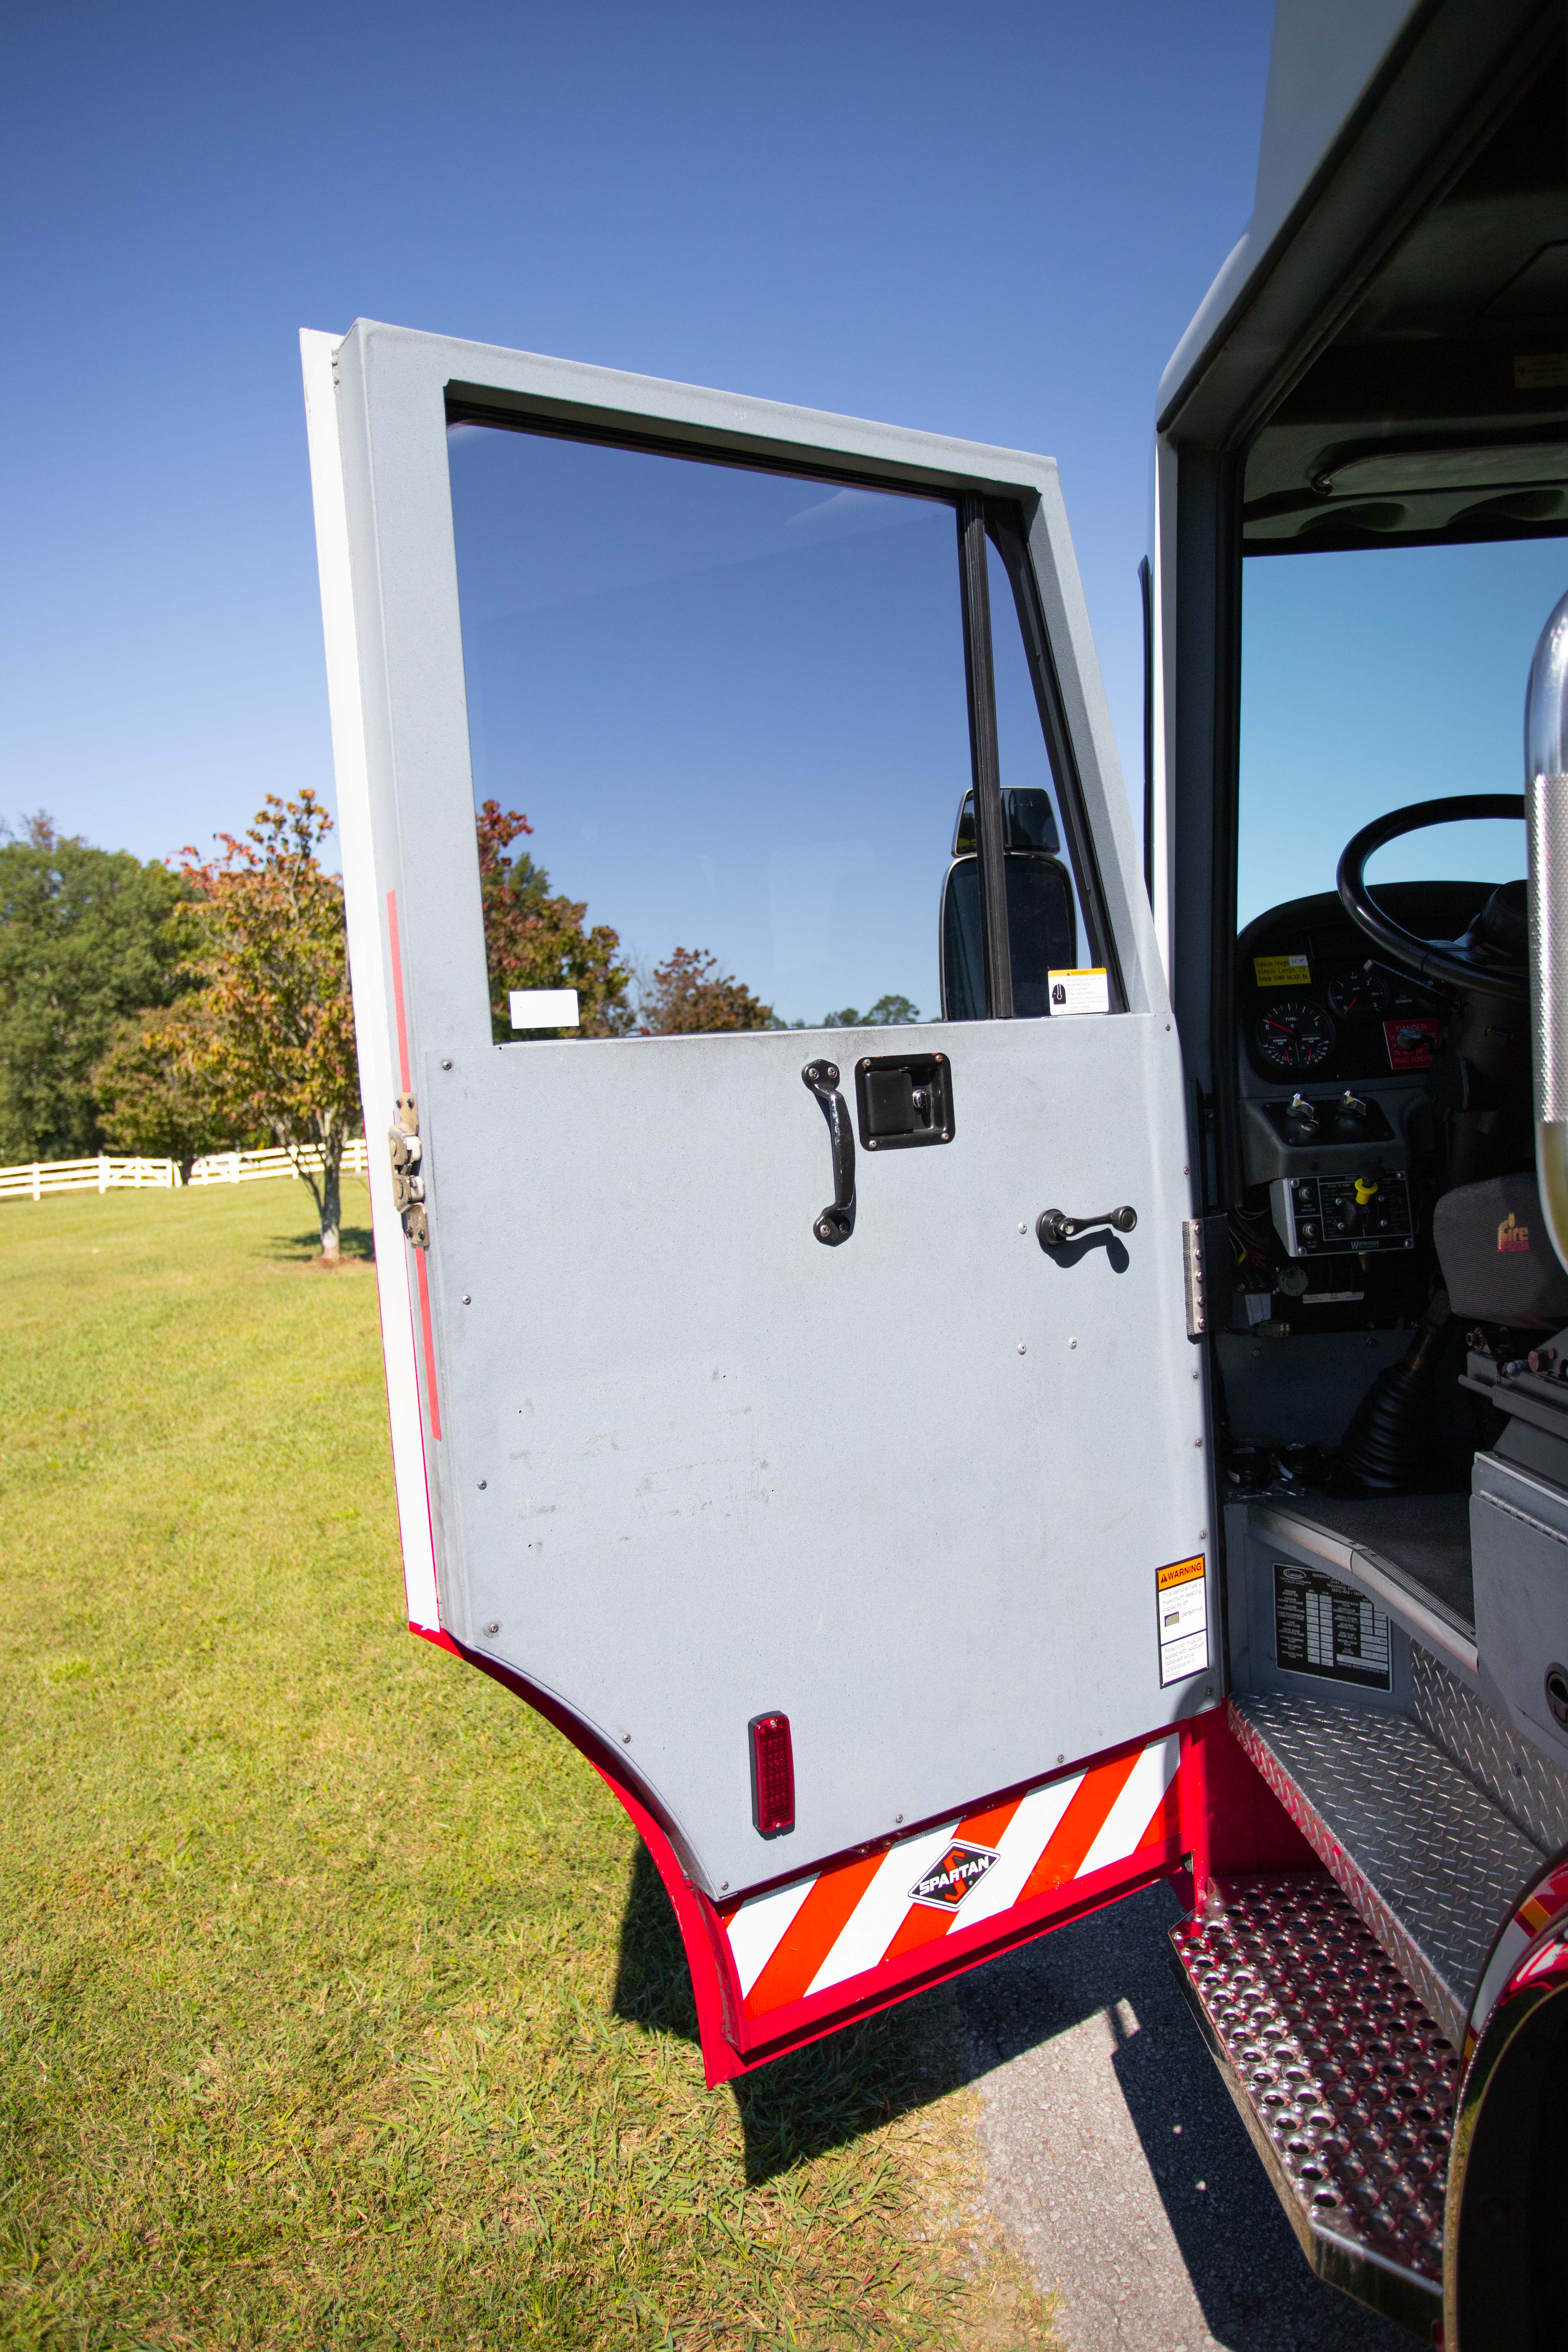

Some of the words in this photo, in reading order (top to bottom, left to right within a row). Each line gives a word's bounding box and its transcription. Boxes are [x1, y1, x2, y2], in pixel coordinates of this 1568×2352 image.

[1351, 1240, 1379, 1250] Waterous
[1167, 1563, 1201, 1580] WARNING
[1173, 1586, 1188, 1595] vehicle
[1162, 1595, 1184, 1605] maximum
[1185, 1588, 1201, 1598] seating
[1163, 1602, 1182, 1613] capacity
[1181, 1605, 1203, 1619] personnel
[1164, 1643, 1185, 1653] Personnel
[1164, 1651, 1178, 1660] seated
[1164, 1656, 1182, 1666] fastened
[1165, 1661, 1185, 1674] apparatus
[1352, 1665, 1380, 1674] IDENTIFICATION
[919, 1856, 989, 1896] SPARTAN
